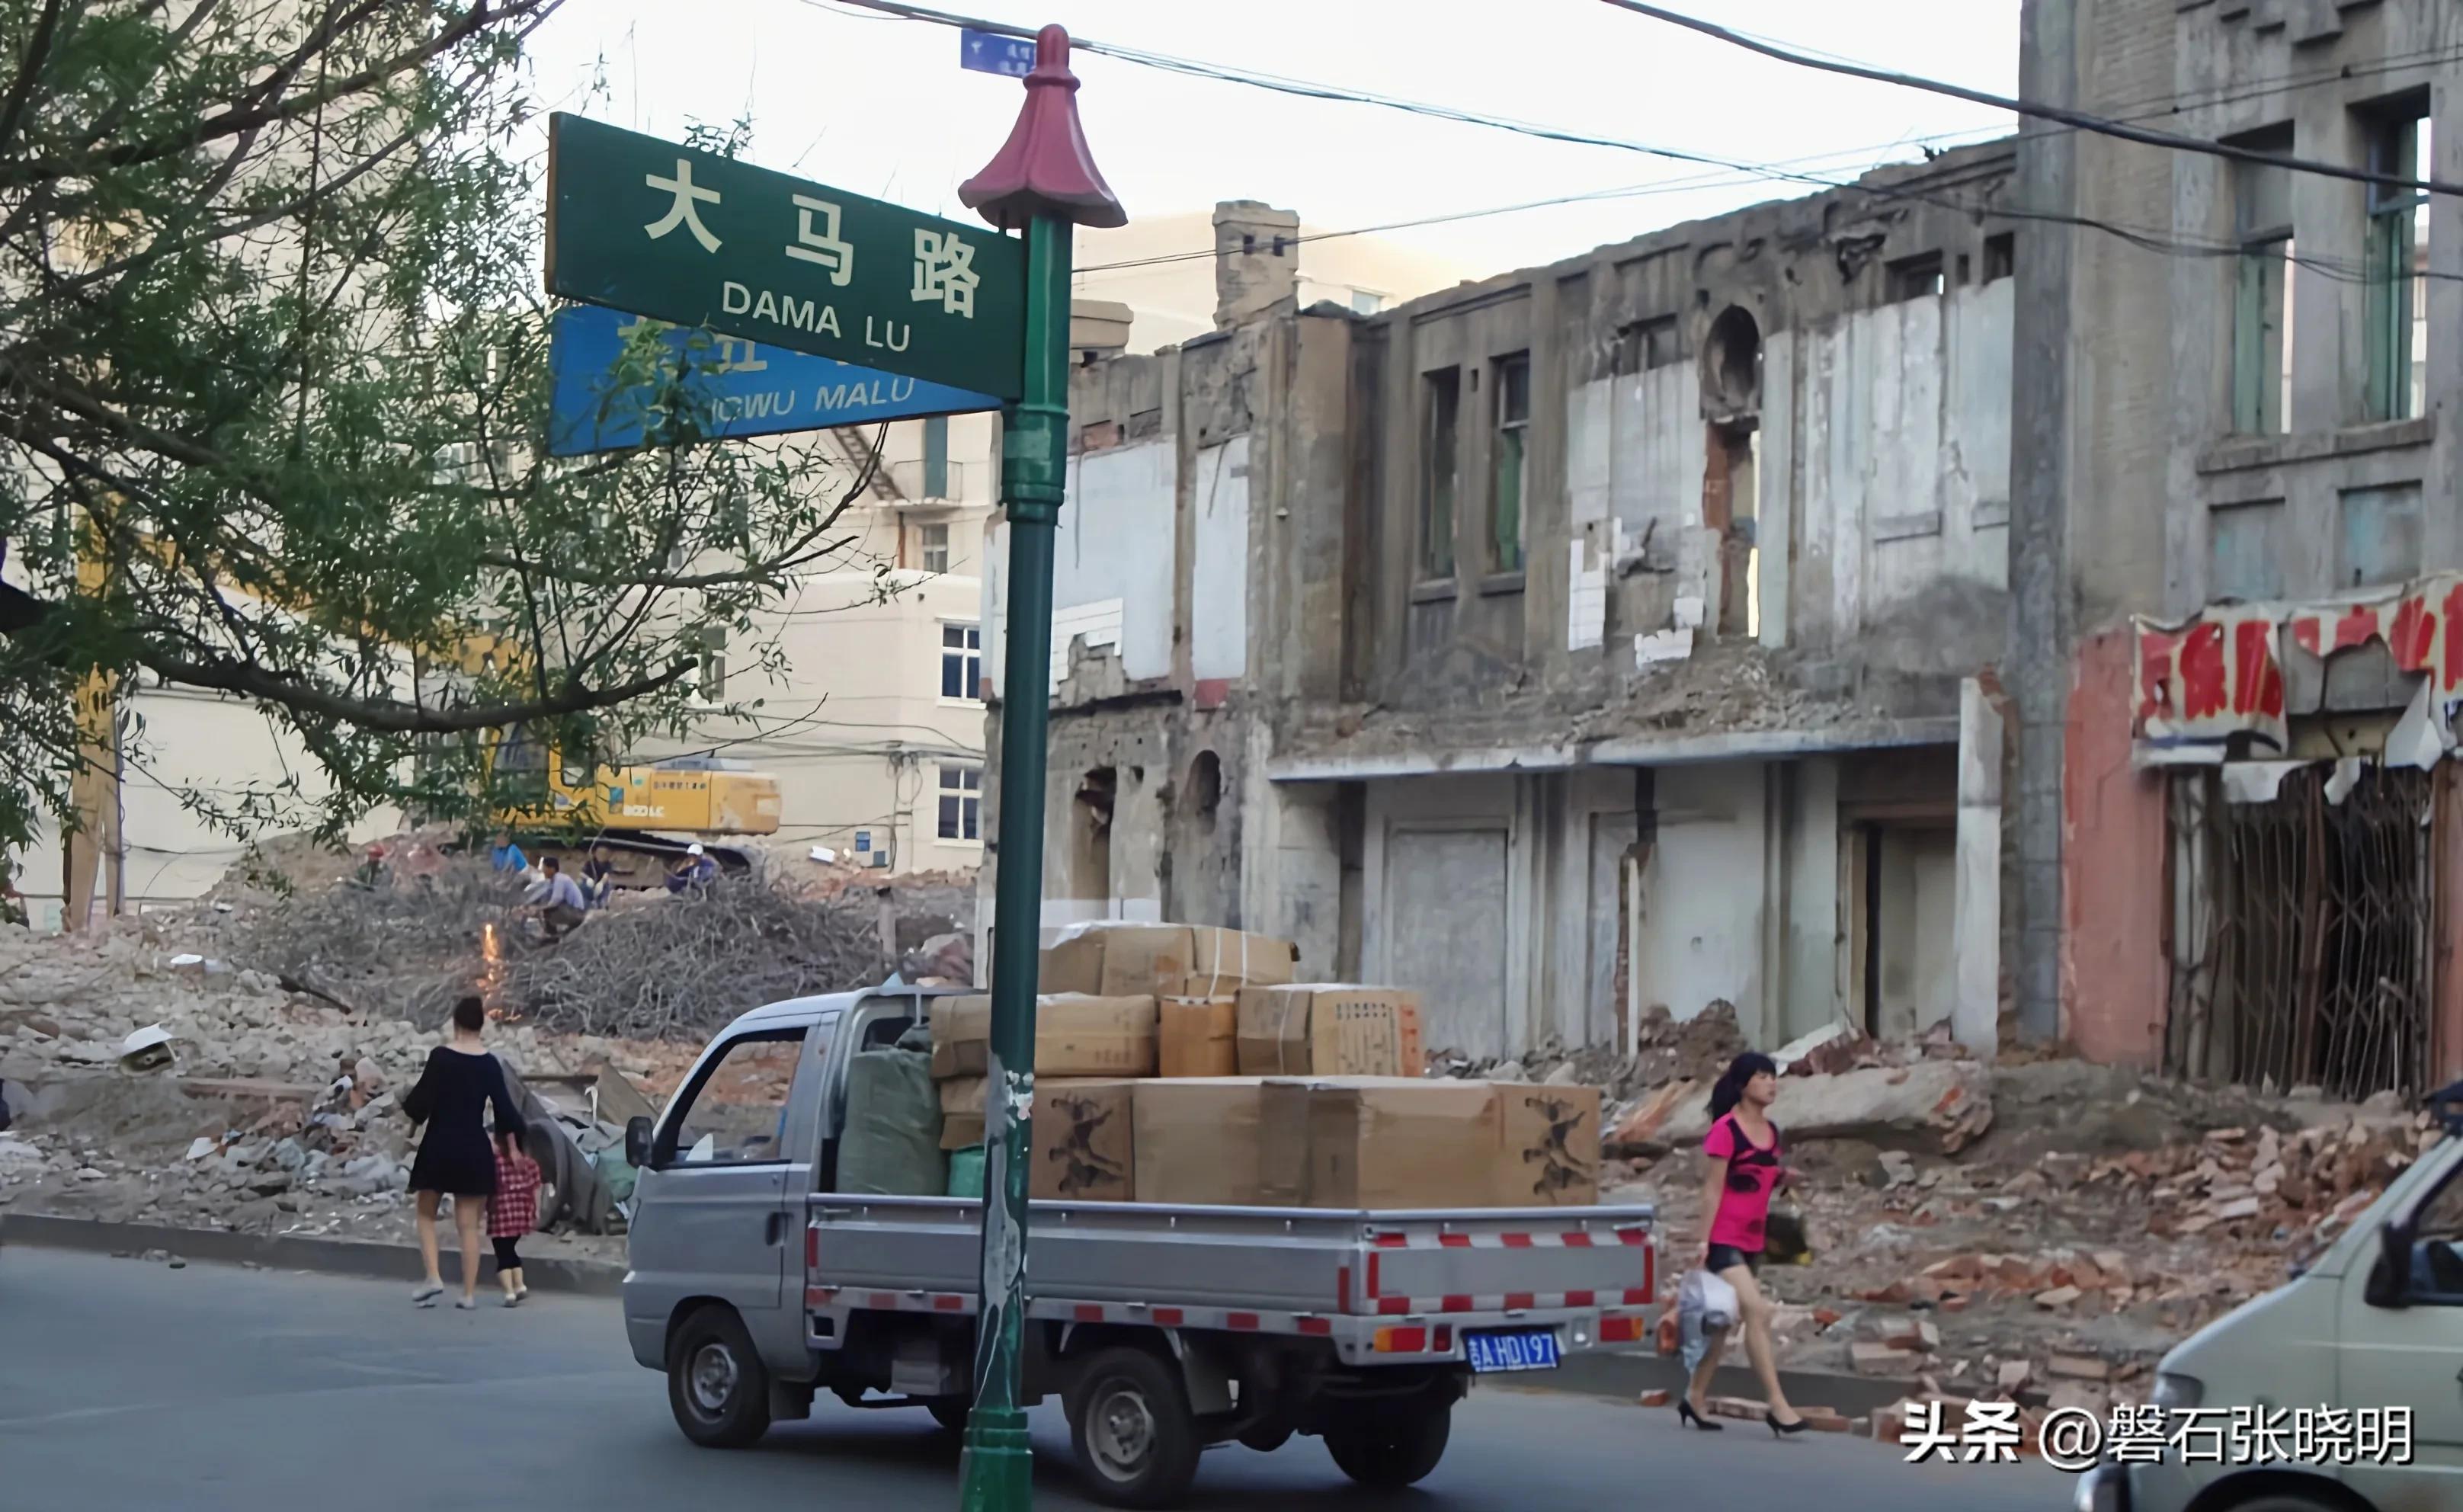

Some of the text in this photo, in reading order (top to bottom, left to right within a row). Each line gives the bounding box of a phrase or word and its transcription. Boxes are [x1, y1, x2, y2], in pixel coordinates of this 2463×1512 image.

[644, 159, 981, 319] 大马路
[722, 280, 841, 338] DAMA
[865, 315, 911, 353] LU
[815, 376, 914, 413] MALU
